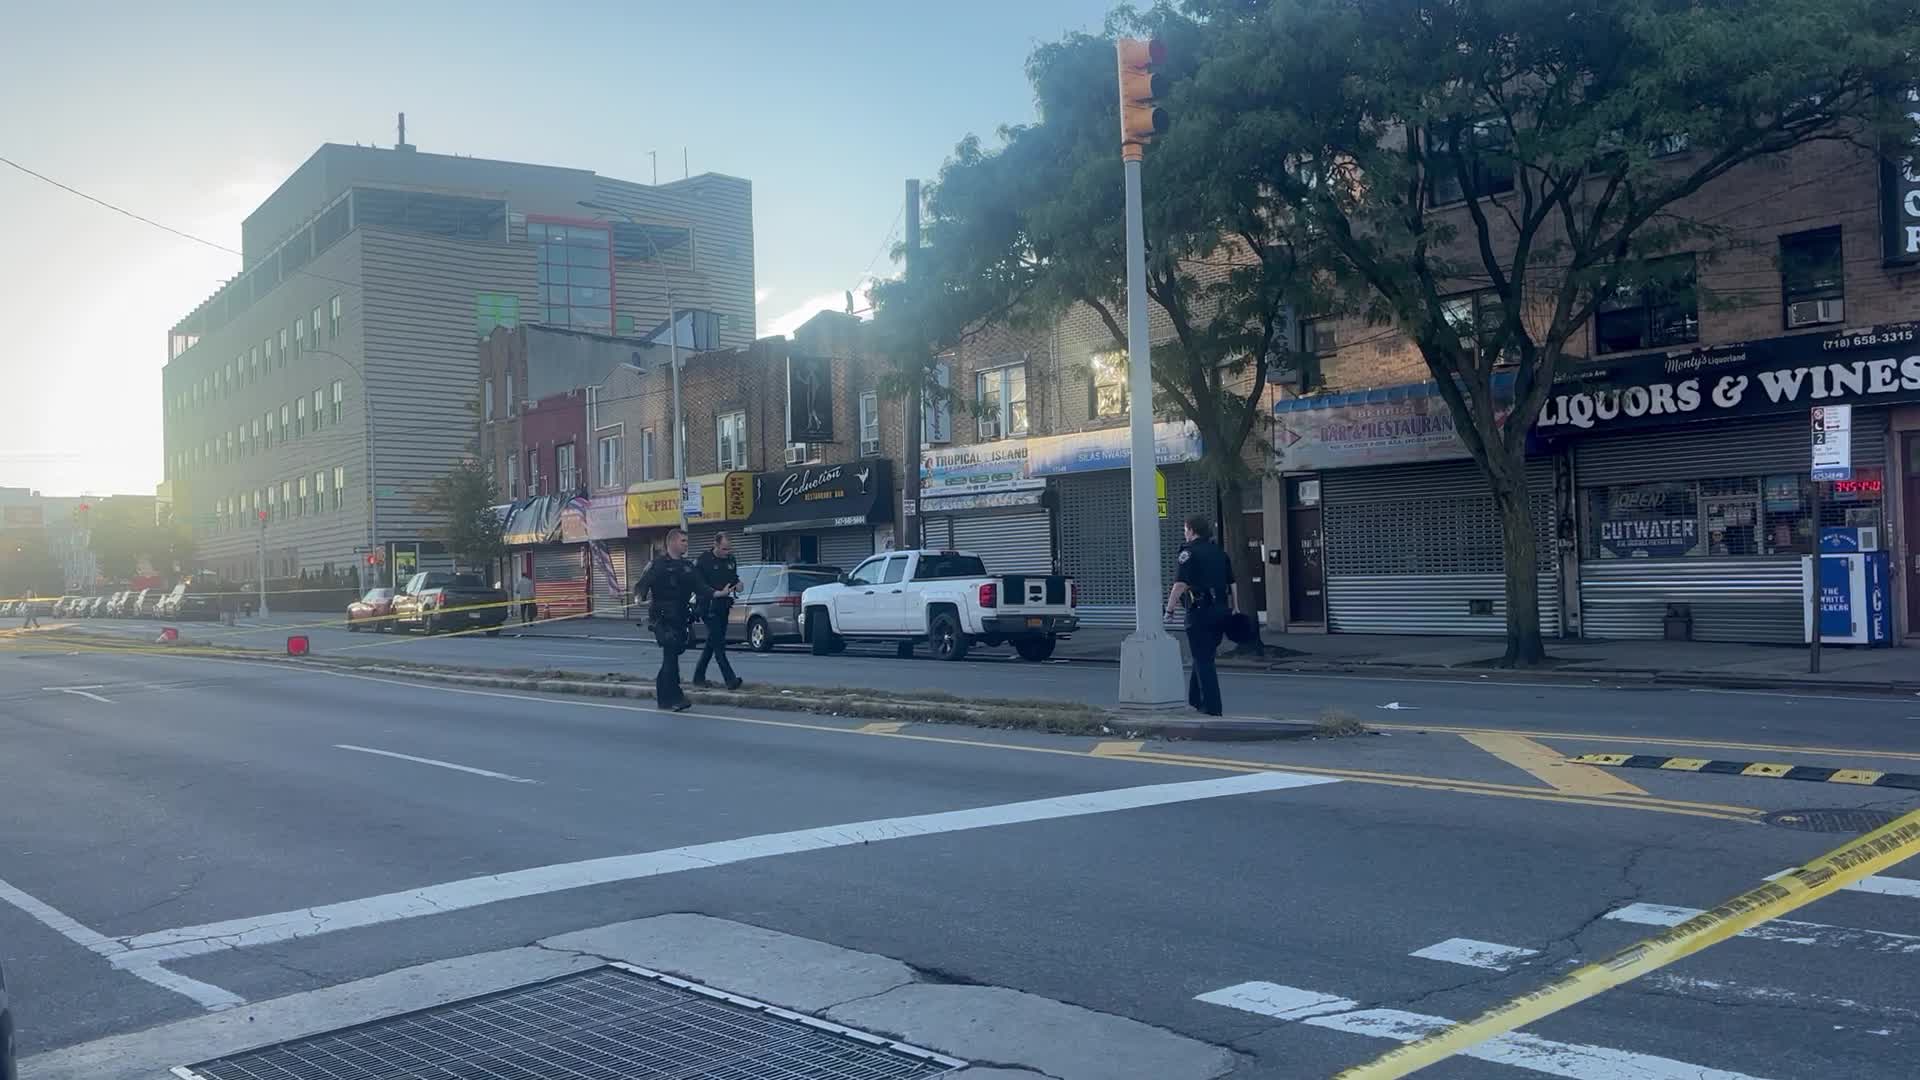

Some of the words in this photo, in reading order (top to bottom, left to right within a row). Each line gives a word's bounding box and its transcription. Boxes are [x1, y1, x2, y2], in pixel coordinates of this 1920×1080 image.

[1823, 338, 1850, 350] (718)
[1853, 330, 1913, 345] 658-3315
[1664, 353, 1707, 374] Monty's
[1707, 352, 1746, 366] Liquorland
[1537, 378, 1701, 428] LIQUORS
[1711, 374, 1749, 408] &
[1757, 355, 1920, 404] WINES
[1367, 415, 1454, 438] RESTAURAN
[1816, 433, 1824, 444] 2
[935, 451, 982, 467] TROPICAL
[991, 447, 1029, 462] ISLAND
[778, 466, 841, 505] Seduction
[655, 499, 680, 511] PRIN
[1601, 519, 1694, 540] CUTWATER
[1872, 560, 1884, 640] ICE
